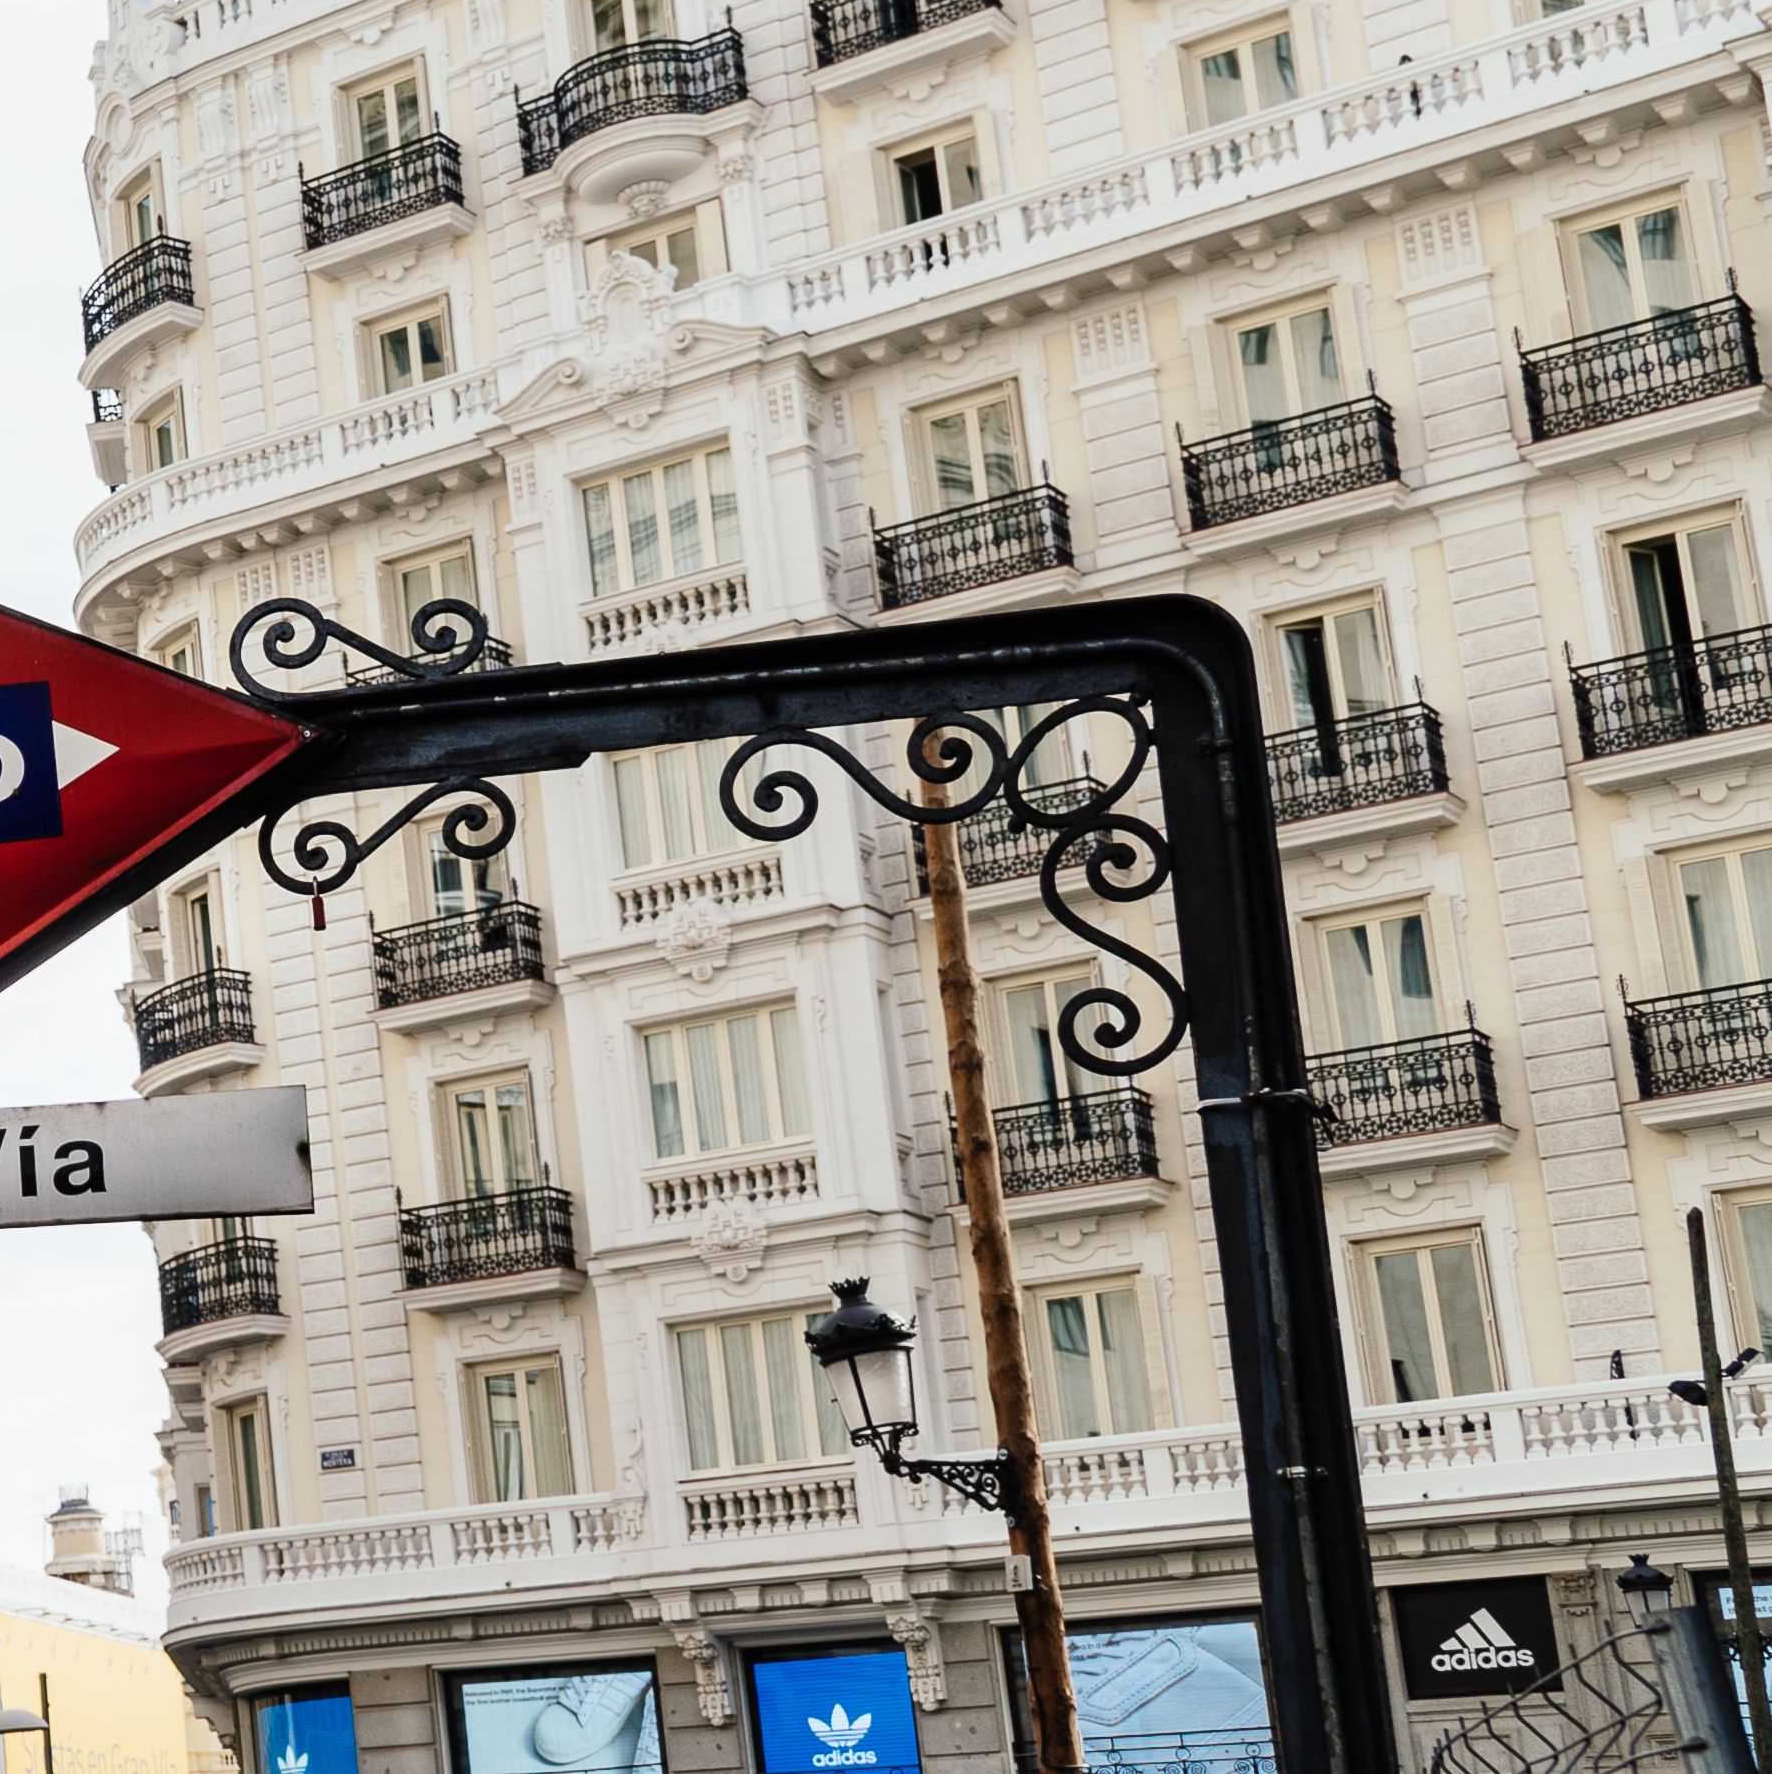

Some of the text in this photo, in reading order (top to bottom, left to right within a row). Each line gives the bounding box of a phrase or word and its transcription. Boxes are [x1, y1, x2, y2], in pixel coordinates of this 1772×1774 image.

[1431, 1646, 1535, 1672] adidas
[50, 1732, 84, 1774] stás
[812, 1748, 877, 1767] adidas
